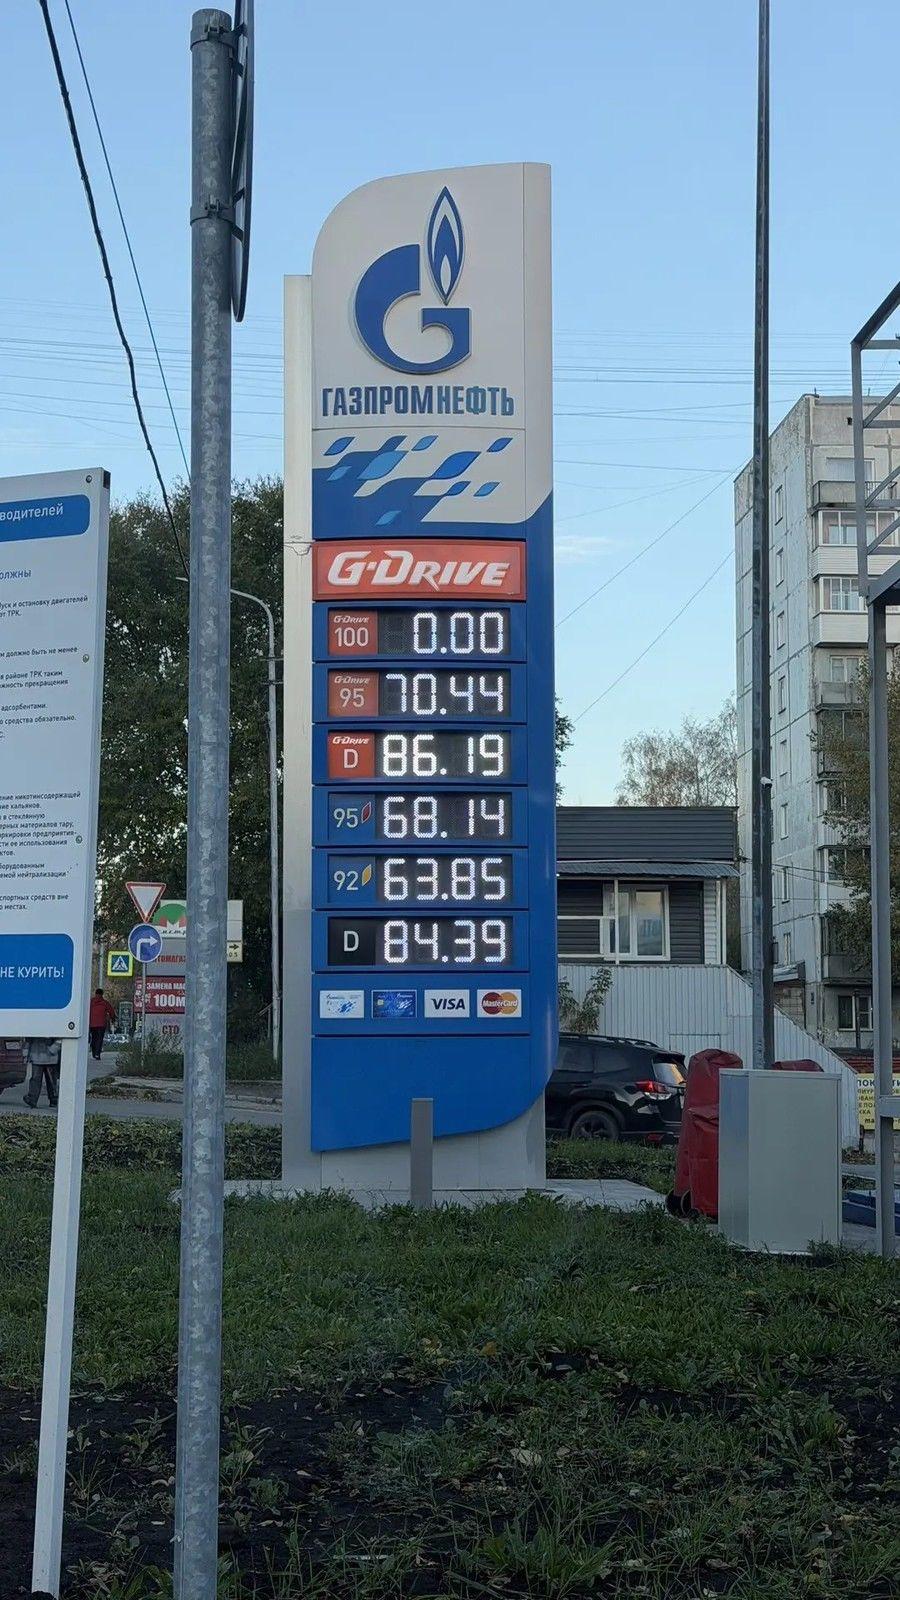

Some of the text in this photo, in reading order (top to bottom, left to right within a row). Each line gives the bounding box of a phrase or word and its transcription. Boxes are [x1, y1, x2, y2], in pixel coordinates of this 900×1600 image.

[322, 385, 515, 417] ГАЗПРОМНЕФТЬ
[0, 503, 64, 521] водителей
[51, 595, 88, 606] двигателей
[334, 628, 369, 648] 100
[413, 612, 504, 654] 0.00
[32, 648, 48, 656] быть
[30, 670, 43, 678] ТРК
[340, 688, 364, 708] 95
[385, 673, 503, 715] 70.44
[343, 749, 359, 769] D
[383, 734, 504, 777] 86.19
[333, 808, 358, 829] 95
[383, 796, 505, 839] 68.14
[333, 870, 359, 891] 92
[383, 858, 506, 901] 63.85
[343, 931, 359, 952] D
[384, 920, 506, 964] 84.39
[0, 966, 65, 979] НЕ КУРИТЬ!
[431, 998, 466, 1010] VISA
[482, 999, 518, 1009] MasterCard
[162, 1026, 180, 1036] СТО
